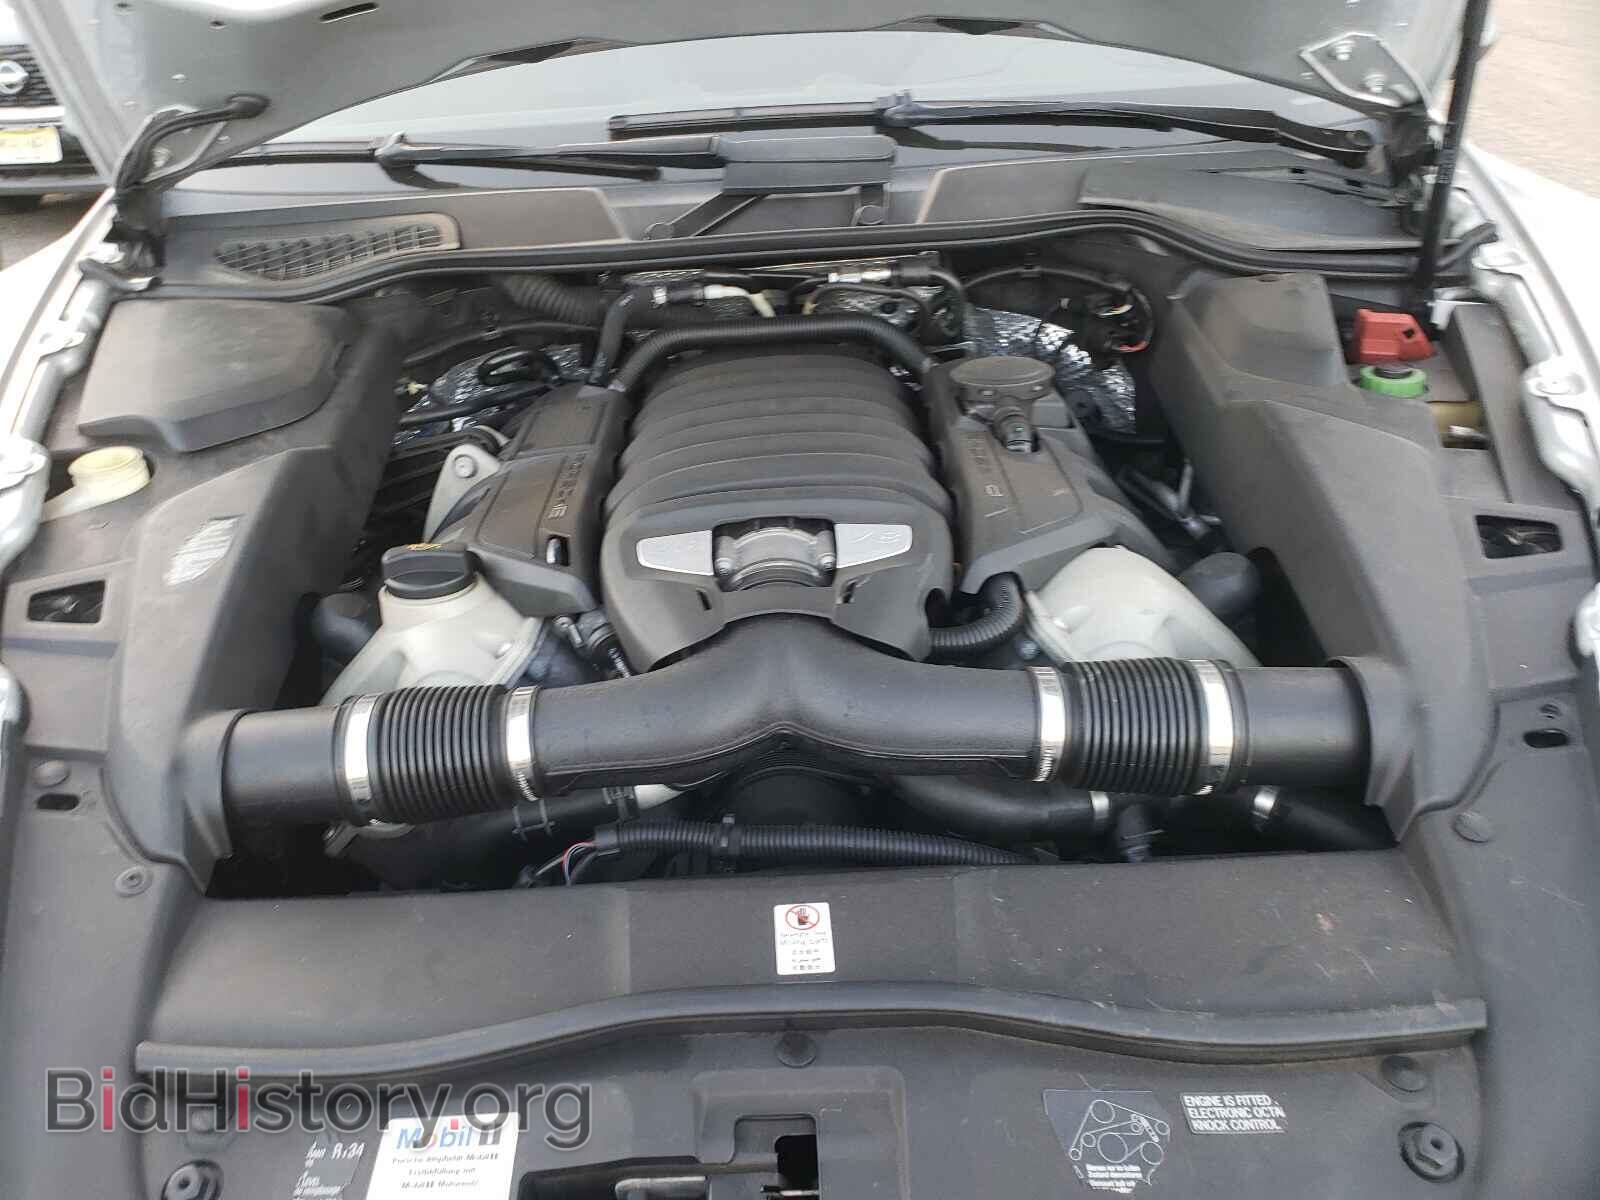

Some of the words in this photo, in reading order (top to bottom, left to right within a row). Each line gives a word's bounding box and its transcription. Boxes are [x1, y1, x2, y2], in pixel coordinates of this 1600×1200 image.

[1183, 1095, 1224, 1106] ENGINE
[1222, 1095, 1236, 1106] IS
[1234, 1094, 1272, 1106] FITTED
[1187, 1107, 1253, 1118] ELECTRONIC
[1191, 1119, 1231, 1131] KNOCK
[1230, 1119, 1282, 1131] CONTROL
